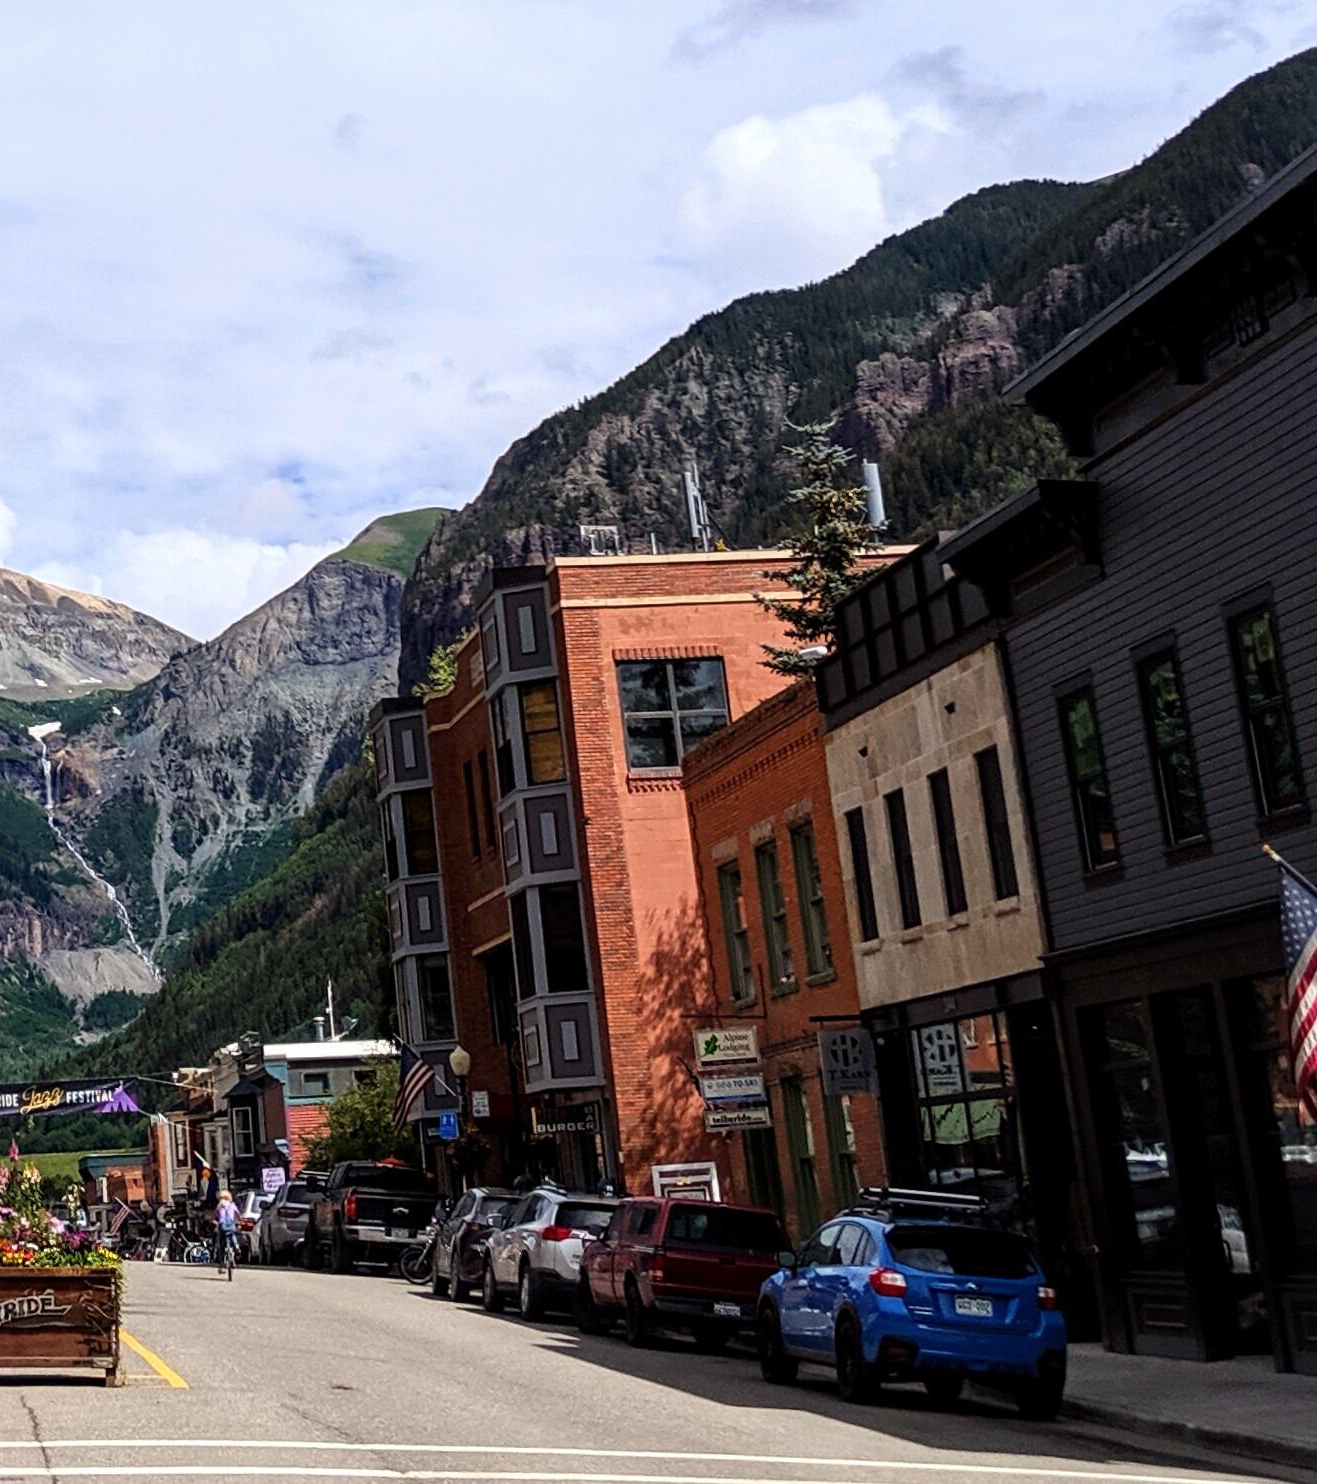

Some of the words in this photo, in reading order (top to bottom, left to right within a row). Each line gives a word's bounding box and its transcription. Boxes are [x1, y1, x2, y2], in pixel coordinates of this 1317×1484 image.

[19, 1086, 64, 1115] Jazz
[66, 1090, 114, 1103] FESTIVAL
[537, 1121, 595, 1133] BURGER
